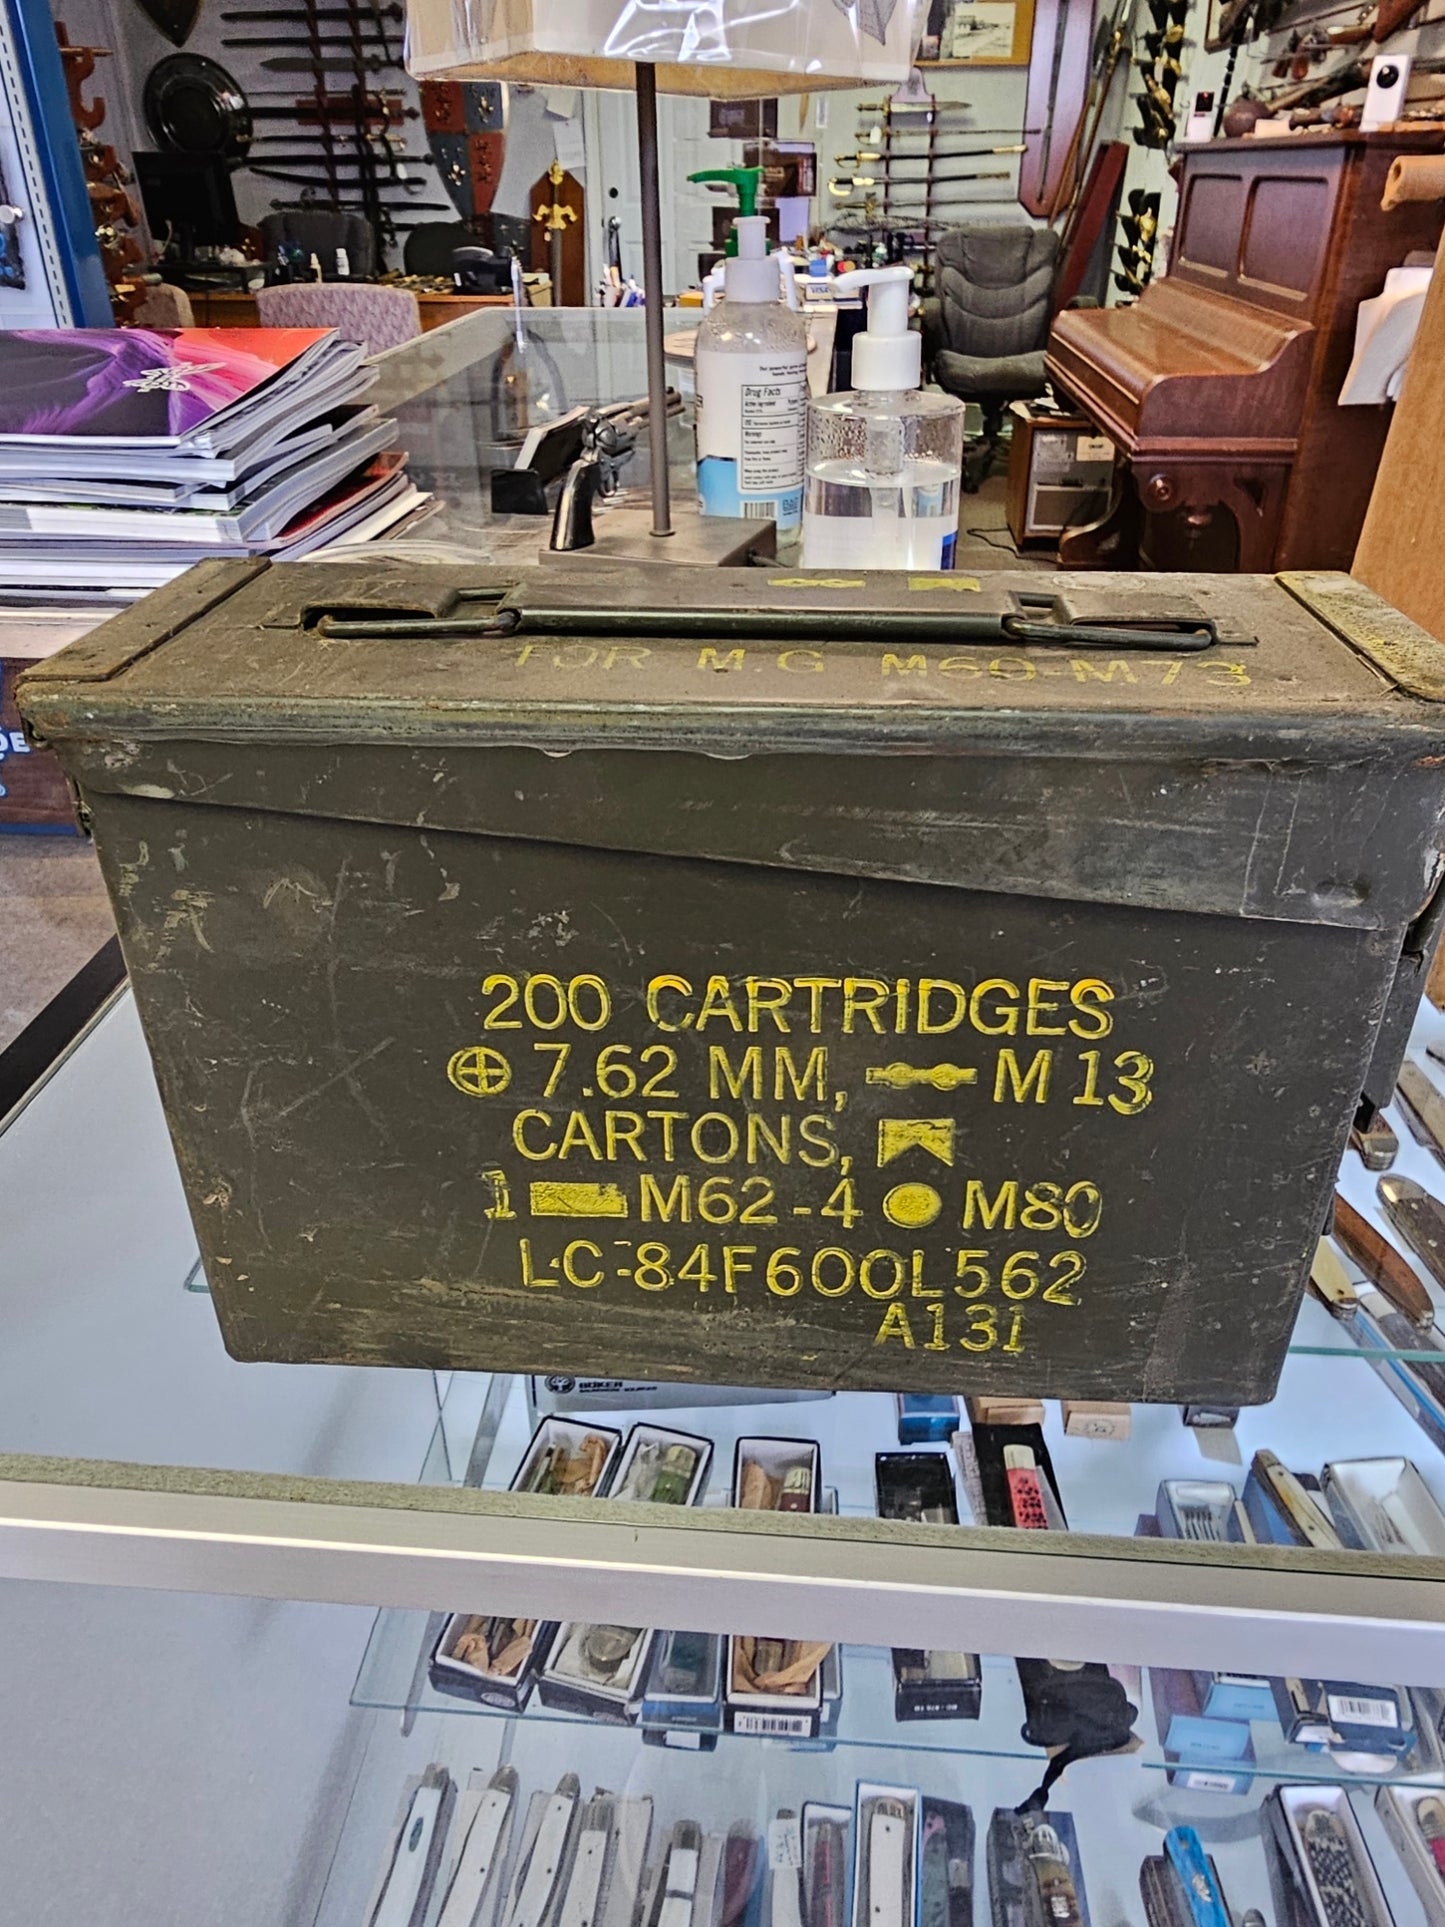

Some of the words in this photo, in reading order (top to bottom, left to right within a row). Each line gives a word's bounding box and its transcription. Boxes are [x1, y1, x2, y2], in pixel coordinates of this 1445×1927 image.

[514, 645, 652, 671] FOR
[481, 973, 612, 1032] 200
[646, 974, 1116, 1041] CARTRIDGES
[533, 1043, 680, 1099] 7.62
[709, 1045, 849, 1113] MM,
[511, 1108, 853, 1175] CARTONS,
[962, 1179, 1103, 1239] M80
